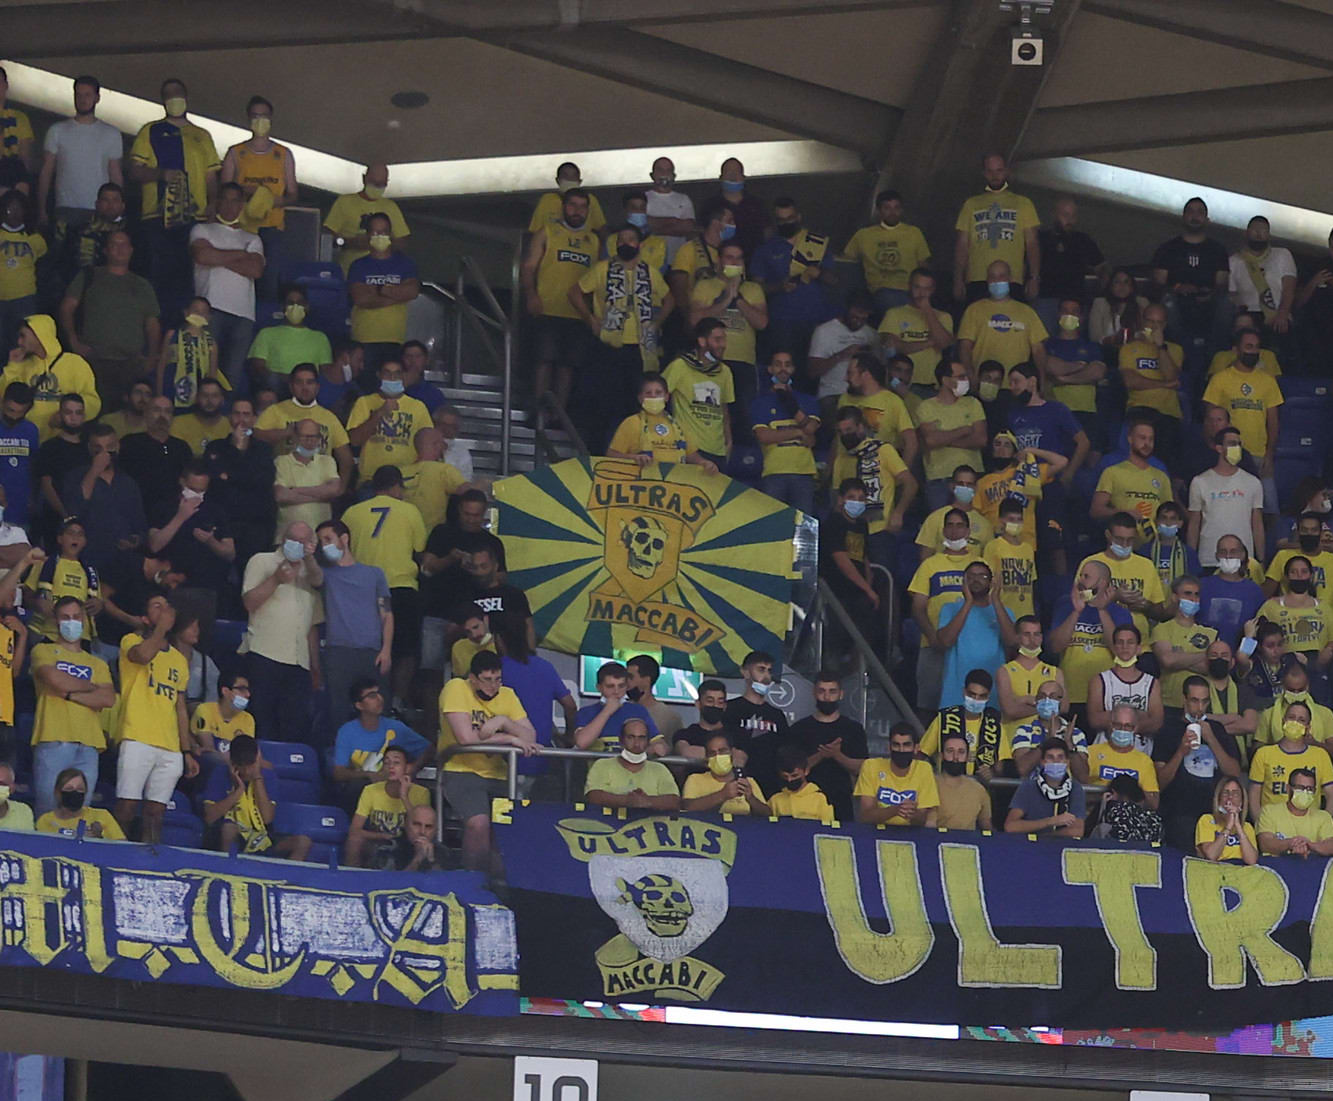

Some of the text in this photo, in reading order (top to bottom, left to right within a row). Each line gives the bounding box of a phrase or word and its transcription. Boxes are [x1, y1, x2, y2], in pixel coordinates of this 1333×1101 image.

[560, 251, 588, 263] FOX
[594, 483, 710, 521] ULTRAS
[371, 507, 391, 537] 7
[592, 602, 712, 644] MACCABI
[880, 791, 914, 803] FOX
[581, 828, 721, 854] ULTRAS
[607, 960, 704, 995] MACCABI
